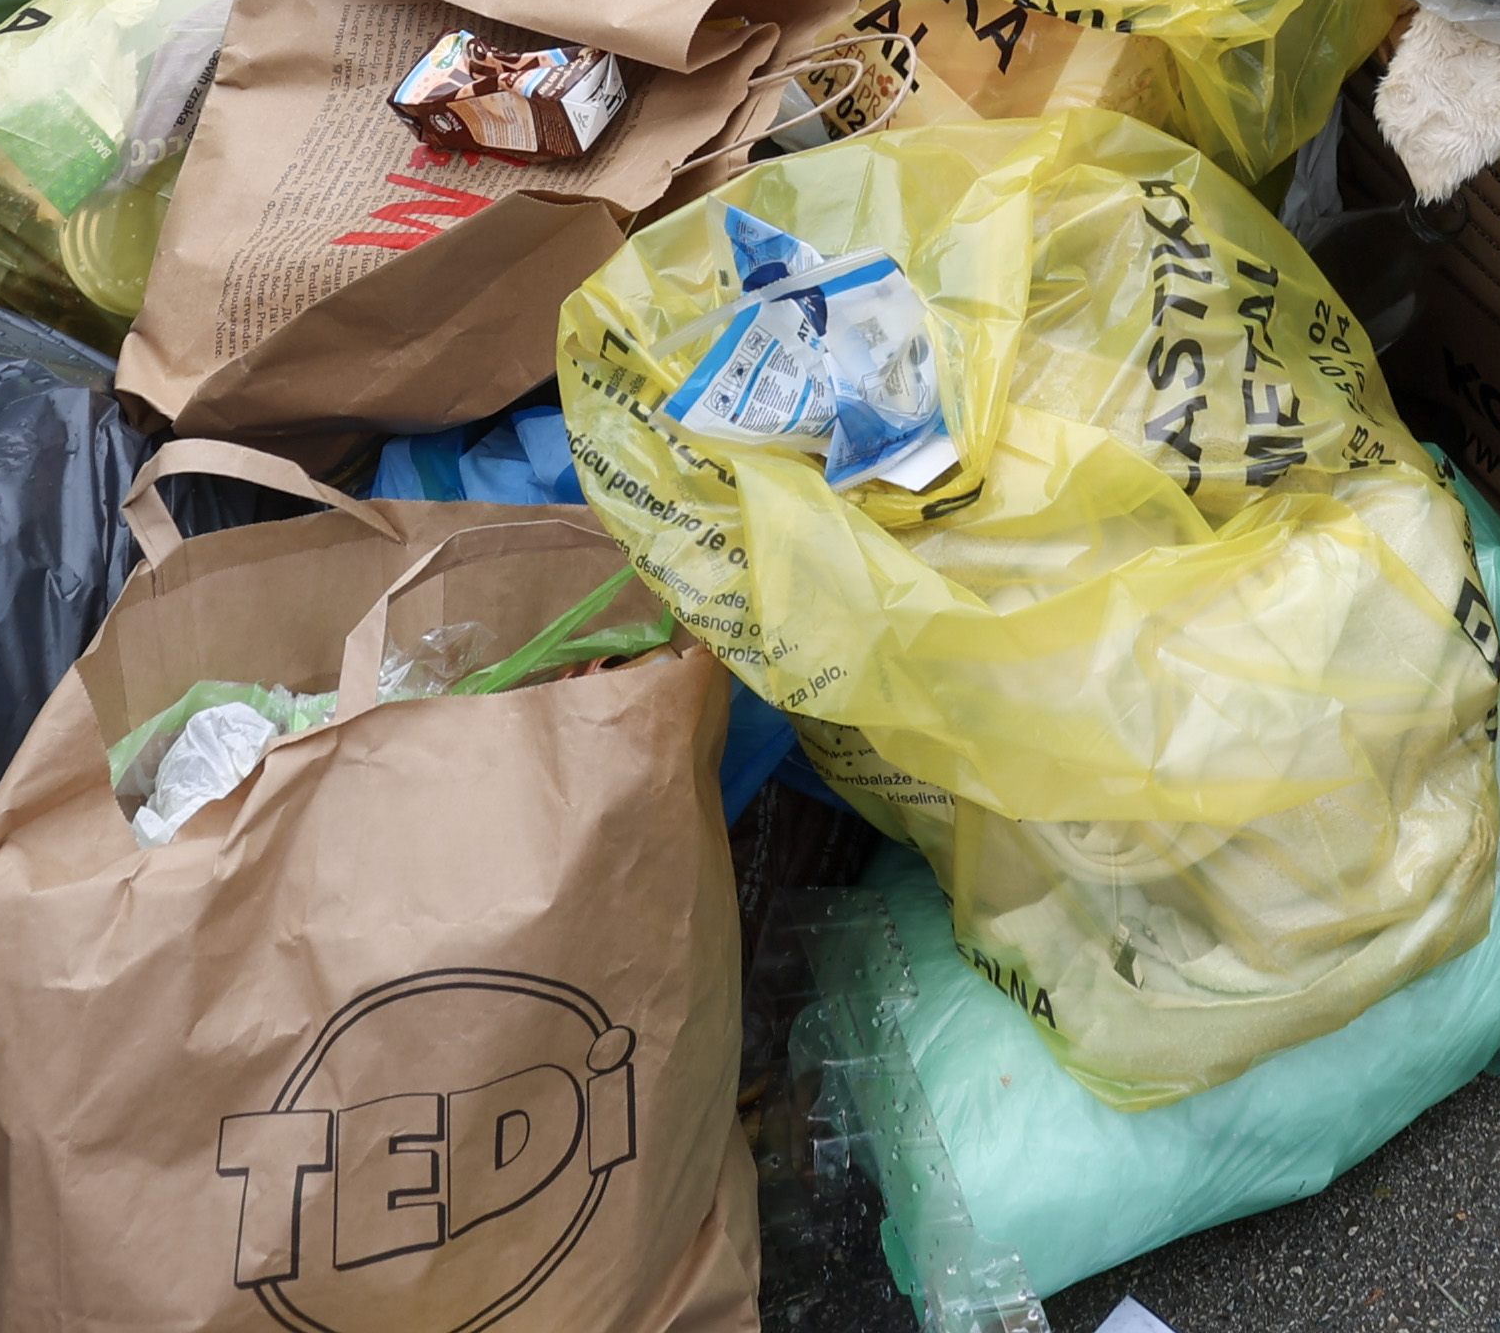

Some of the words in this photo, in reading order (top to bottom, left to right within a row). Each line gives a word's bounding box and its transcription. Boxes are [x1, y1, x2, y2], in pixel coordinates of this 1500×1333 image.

[1308, 299, 1333, 346] 02
[606, 465, 704, 534] potrebno
[695, 523, 727, 553] je
[786, 687, 809, 711] za
[808, 662, 849, 701] jelo,
[218, 1023, 637, 1289] TEDi
